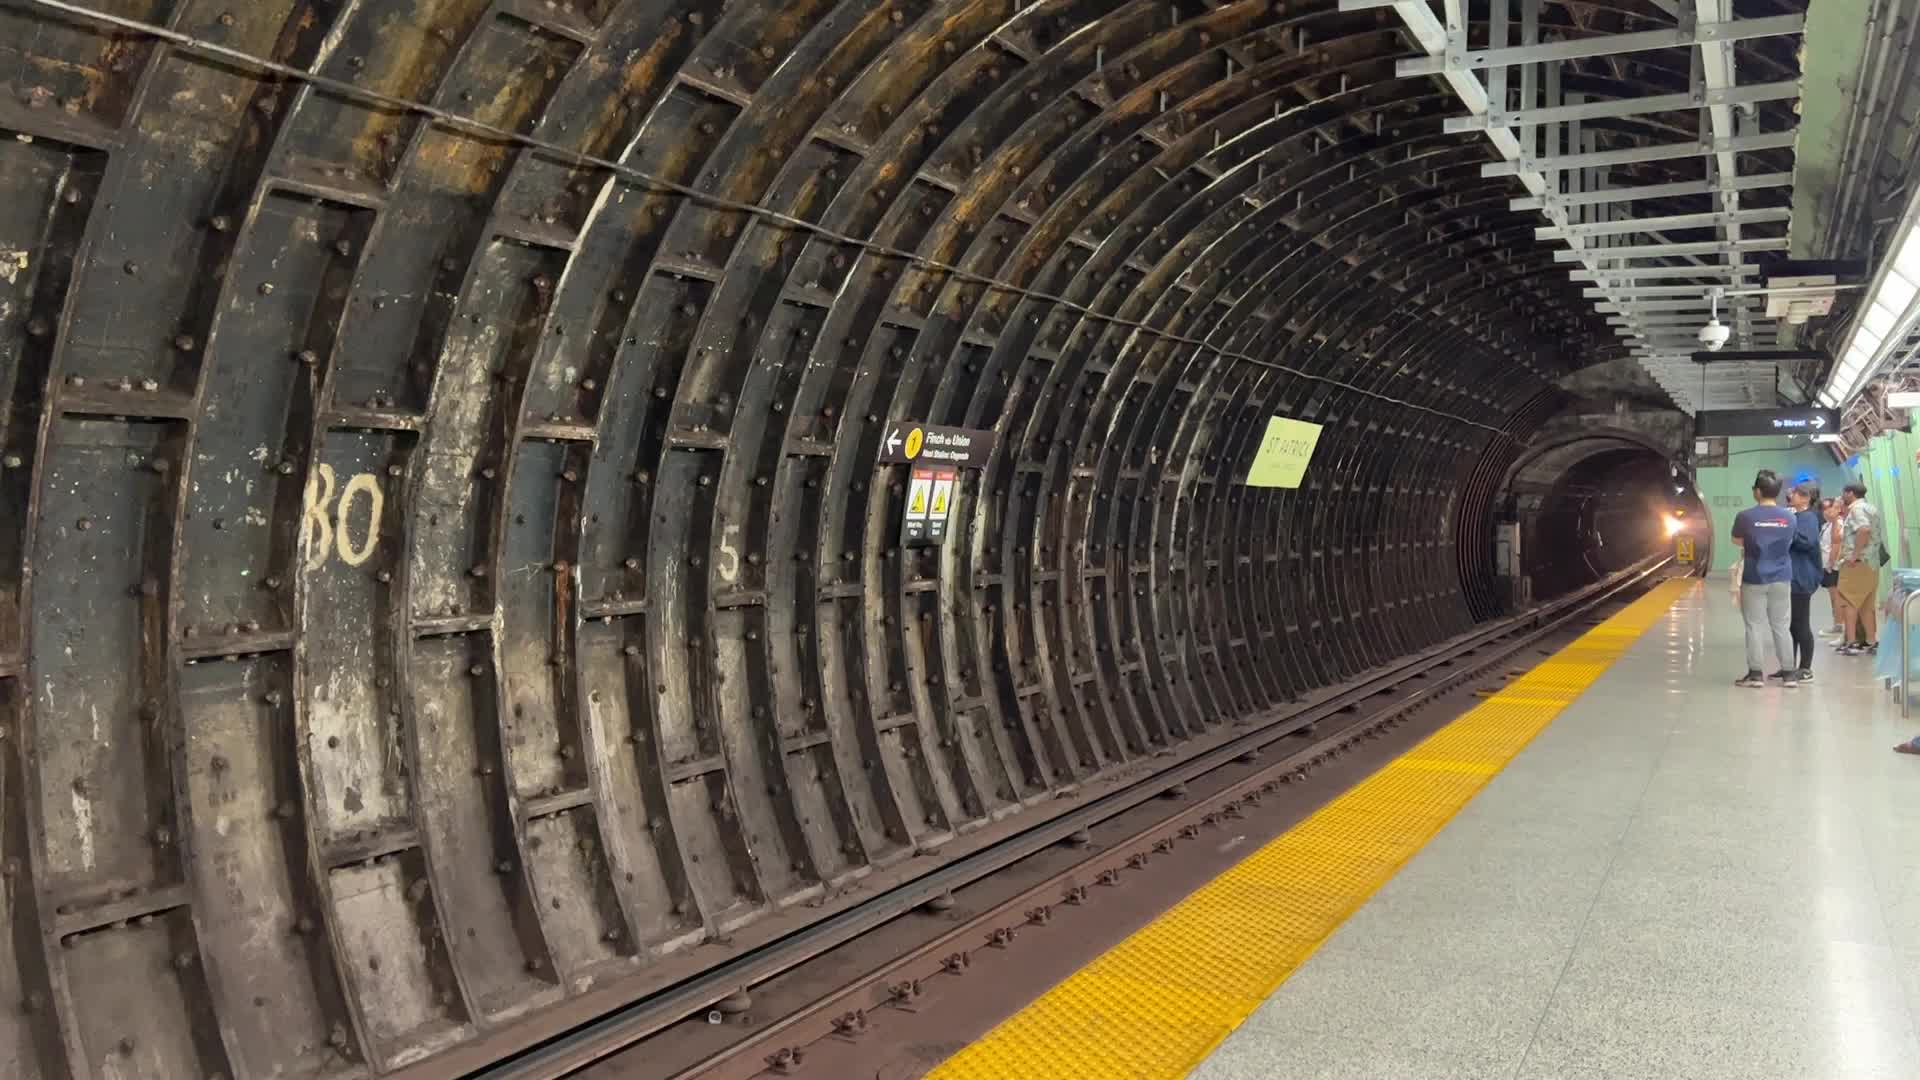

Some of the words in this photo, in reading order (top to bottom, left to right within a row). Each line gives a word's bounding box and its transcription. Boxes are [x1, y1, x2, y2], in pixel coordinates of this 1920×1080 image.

[926, 431, 944, 444] Finch
[952, 434, 971, 447] Union
[719, 525, 739, 581] 5
